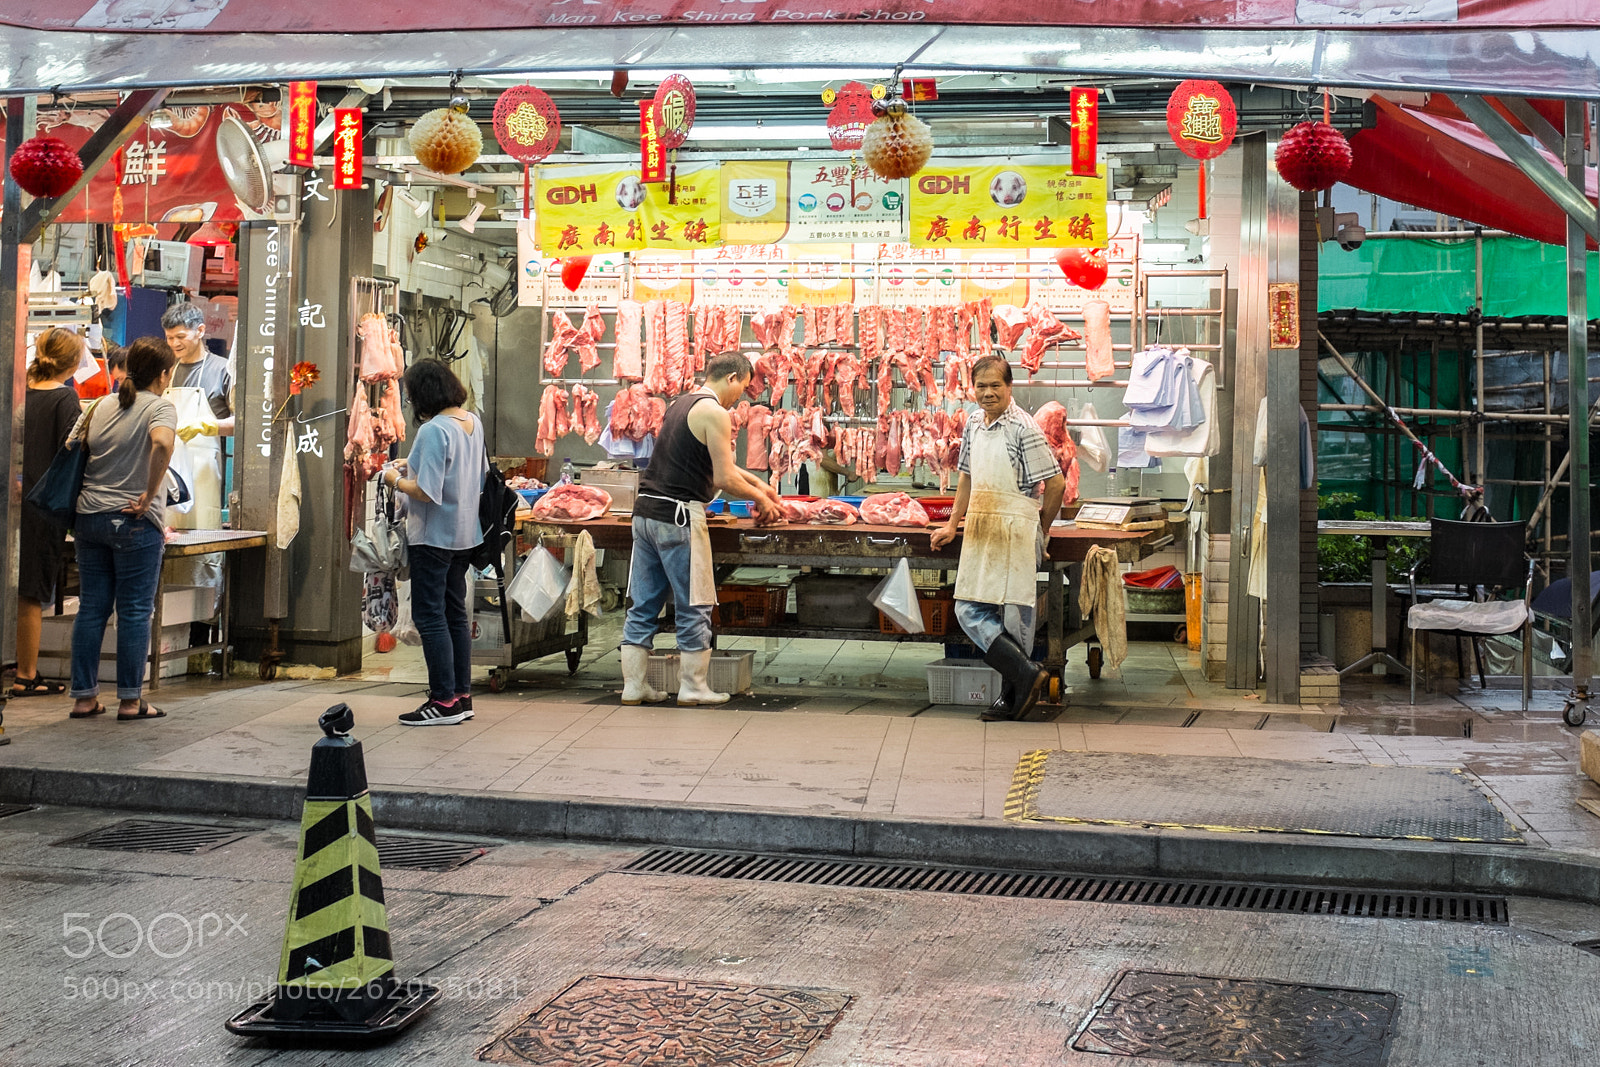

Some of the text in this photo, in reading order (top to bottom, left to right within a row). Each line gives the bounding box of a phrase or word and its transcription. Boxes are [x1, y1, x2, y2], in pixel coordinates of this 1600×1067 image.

[544, 9, 926, 24] Man Kee Shing Pork Shop
[662, 89, 686, 130] 福
[122, 140, 168, 187] 鮮
[546, 183, 598, 205] GDH
[918, 175, 970, 195] GDH
[557, 217, 710, 251] 廣南行生豬
[926, 213, 1096, 243] 廣南行生豬
[970, 692, 983, 700] XXL
